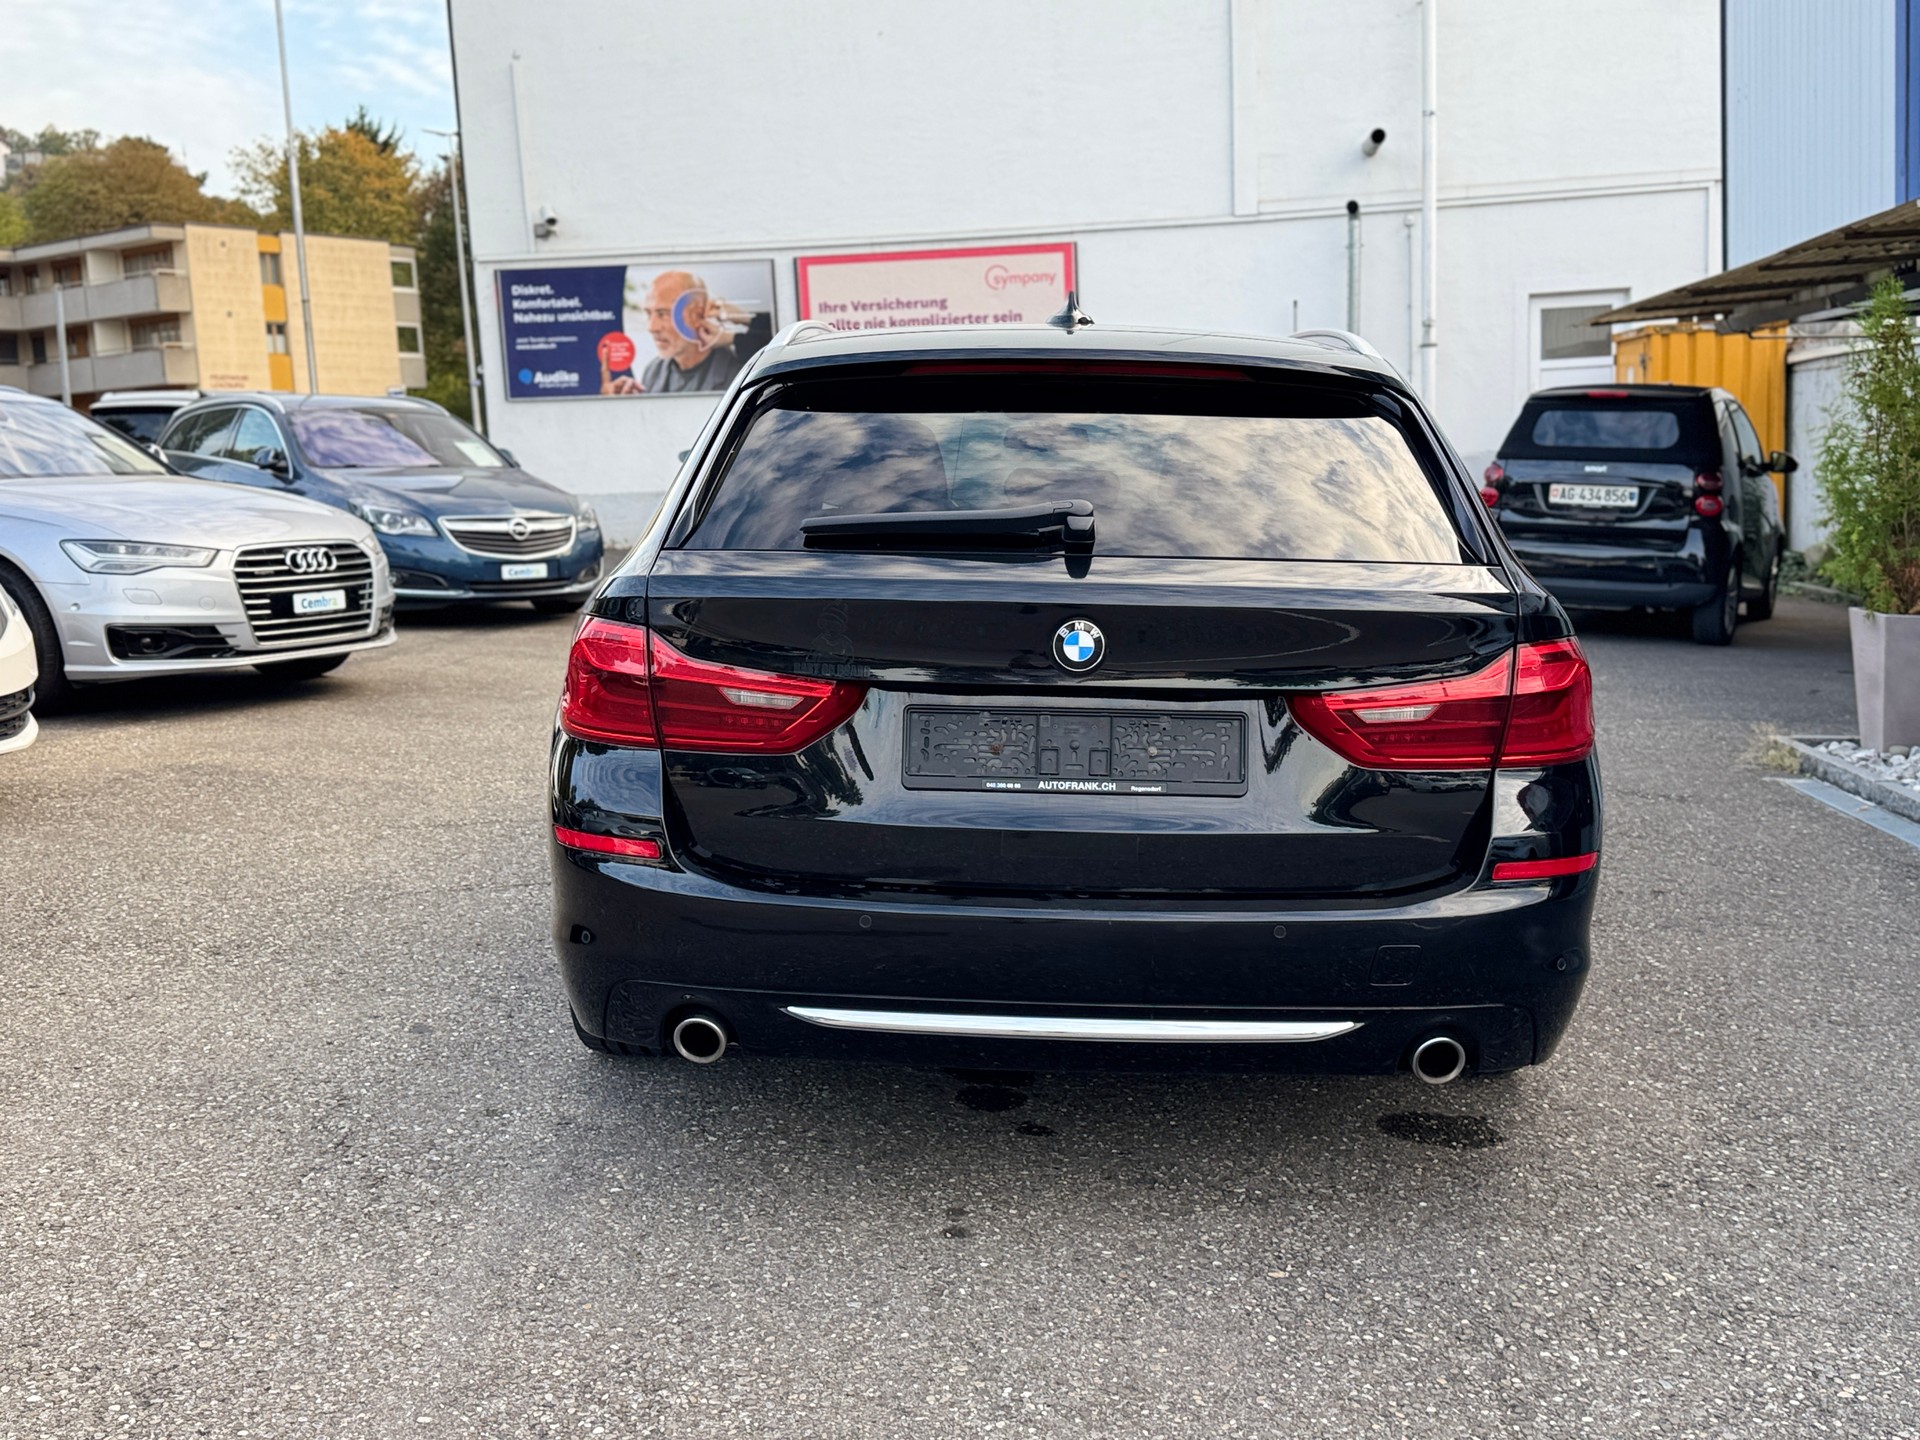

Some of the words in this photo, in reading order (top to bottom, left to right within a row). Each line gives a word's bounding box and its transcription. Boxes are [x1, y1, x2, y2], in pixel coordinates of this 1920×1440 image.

[992, 270, 1056, 289] sympany
[511, 284, 554, 296] Diskret.
[512, 297, 582, 310] Komfortabel.
[818, 302, 848, 314] Ihre
[851, 298, 948, 312] Versicherung
[513, 312, 555, 324] Nahezu
[557, 310, 616, 322] unsichtbar.
[826, 319, 860, 331] ollte
[863, 317, 886, 329] nie
[889, 313, 989, 328] komplizierter
[992, 310, 1023, 323] sein
[533, 370, 579, 384] Audika
[1559, 487, 1575, 500] AG
[508, 567, 541, 577] Cembra
[301, 597, 338, 609] Cembra
[1059, 622, 1100, 639] BMW
[1038, 780, 1117, 792] AUTOFRANK.CH
[1130, 785, 1162, 793] Regensdorf
